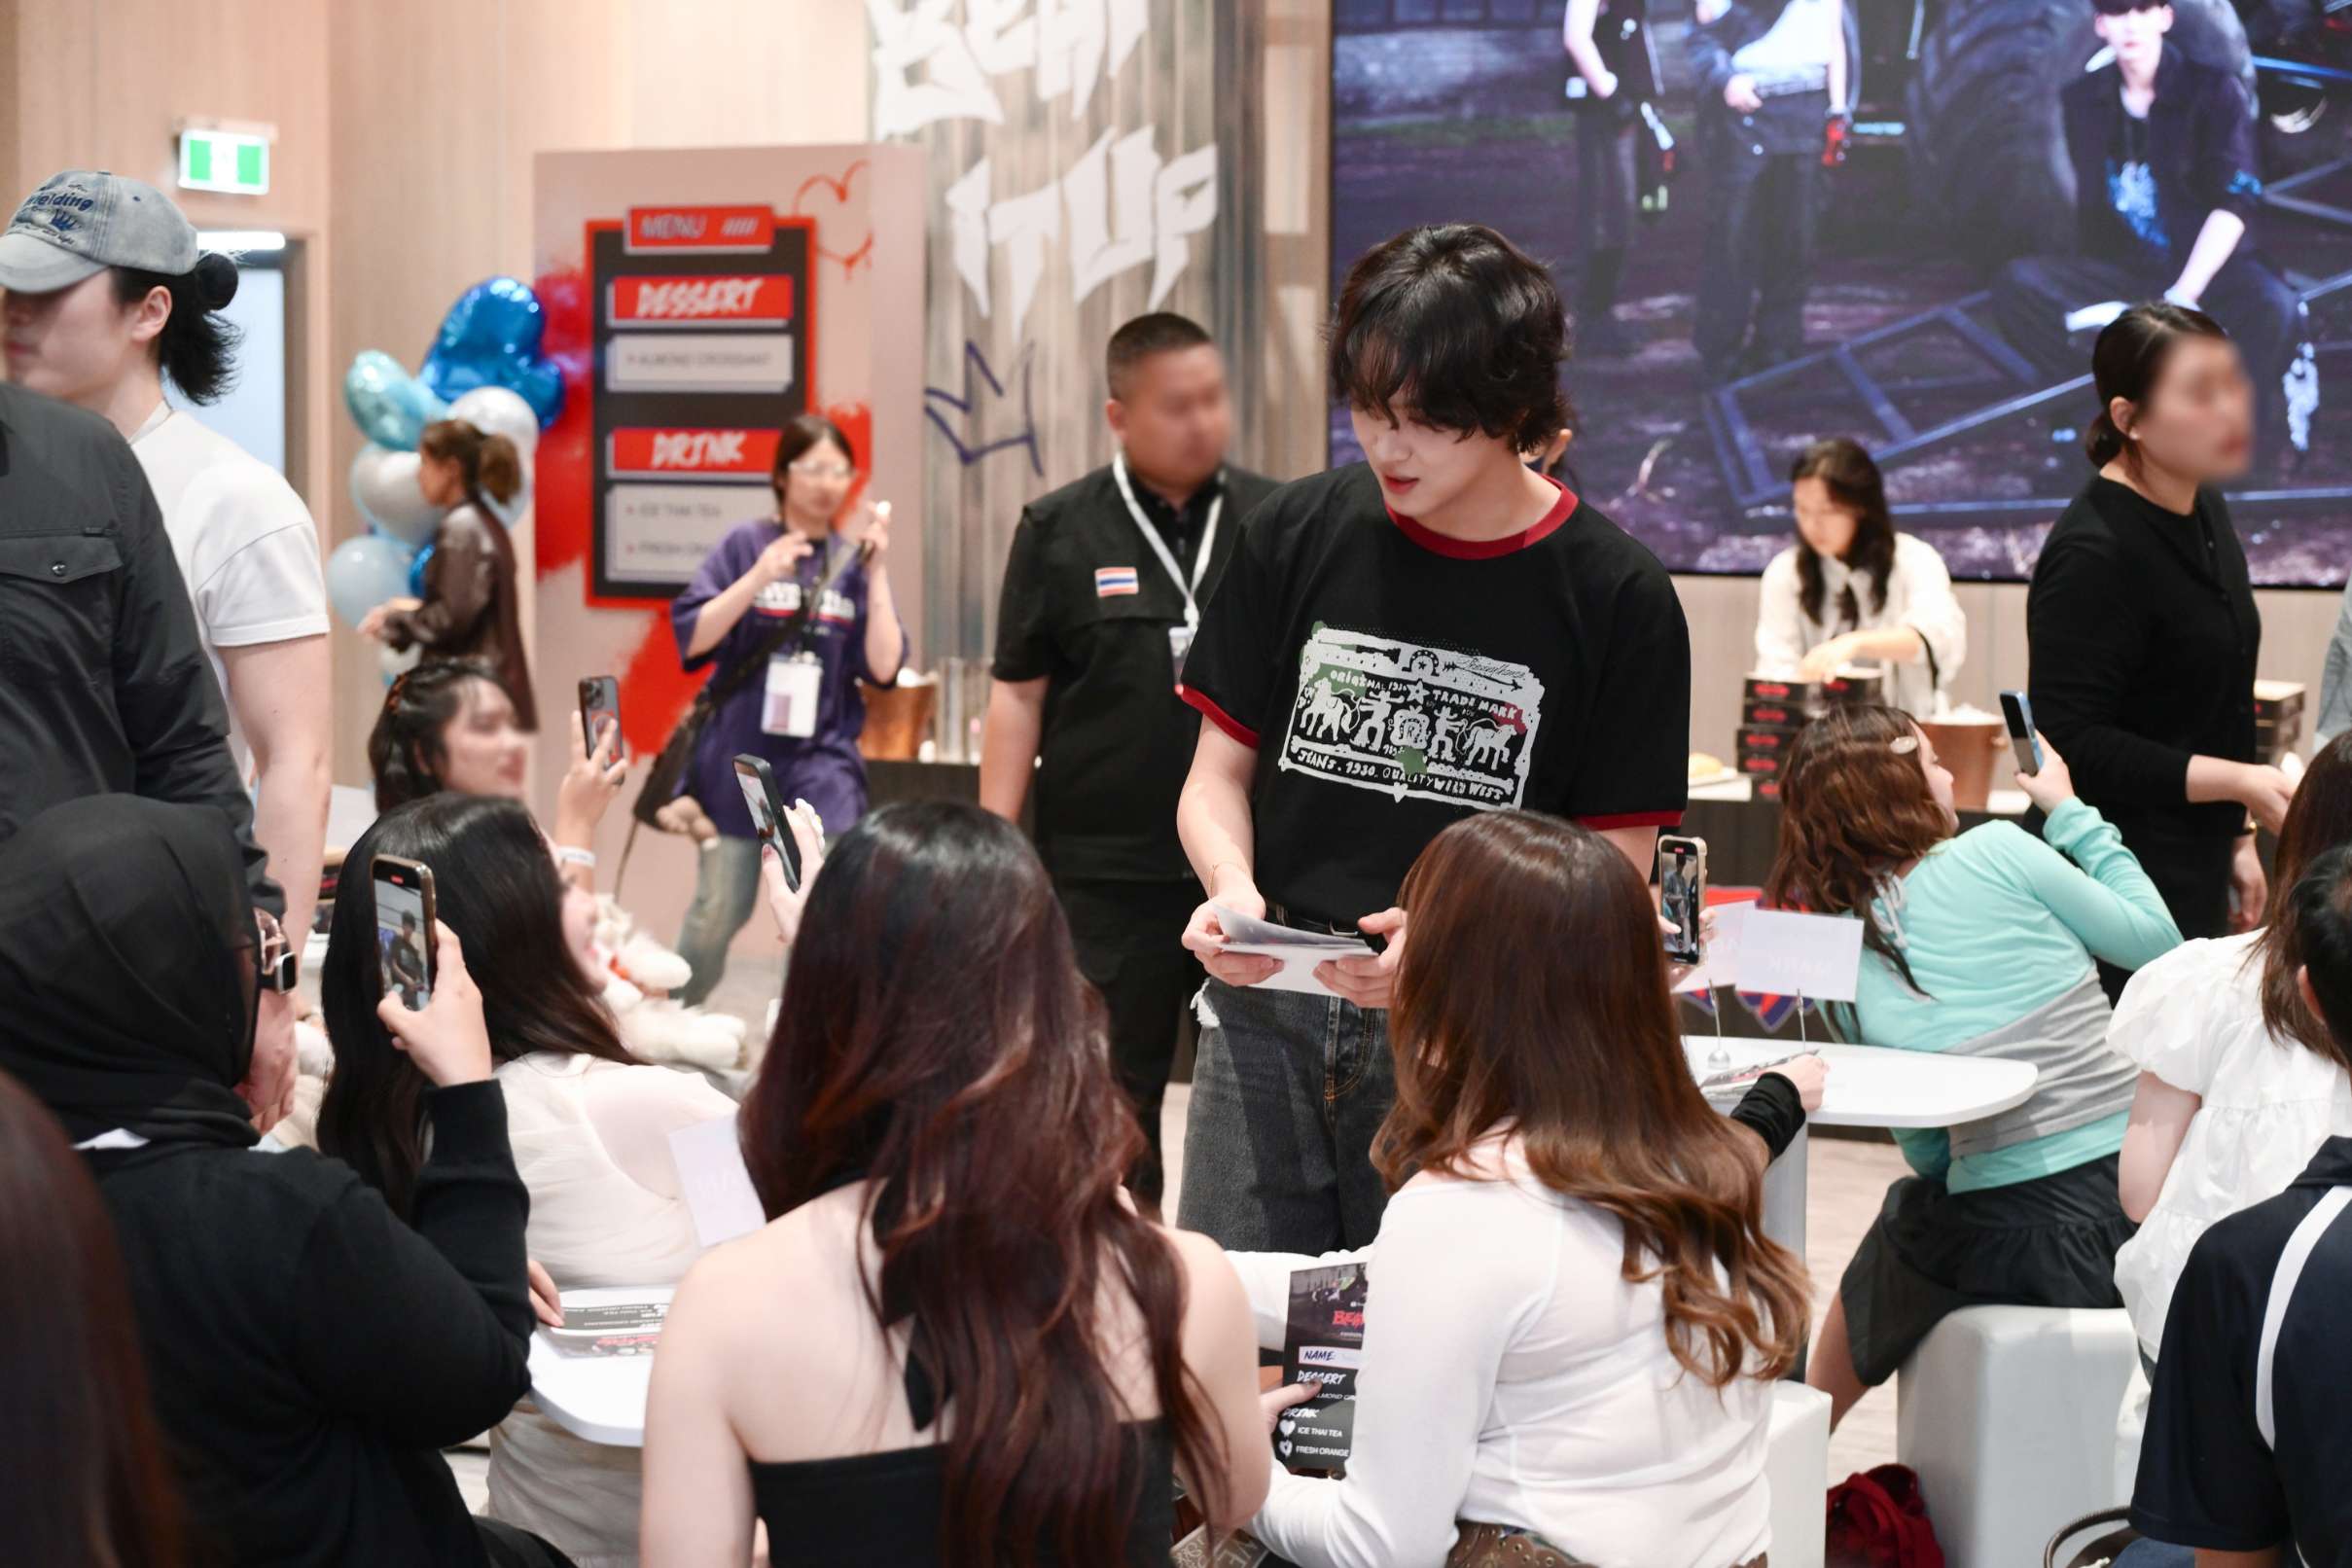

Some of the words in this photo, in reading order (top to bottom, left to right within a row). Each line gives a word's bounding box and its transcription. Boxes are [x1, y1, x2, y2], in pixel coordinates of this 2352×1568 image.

[638, 214, 708, 239] MENU
[635, 277, 765, 317] DESSERT
[650, 432, 747, 468] DRINK
[1382, 767, 1434, 787] QUALITY
[1282, 1407, 1320, 1418] DRINK
[1329, 1429, 1343, 1438] TEA
[1296, 1445, 1319, 1455] FRESH
[1319, 1446, 1350, 1457] ORANGE
